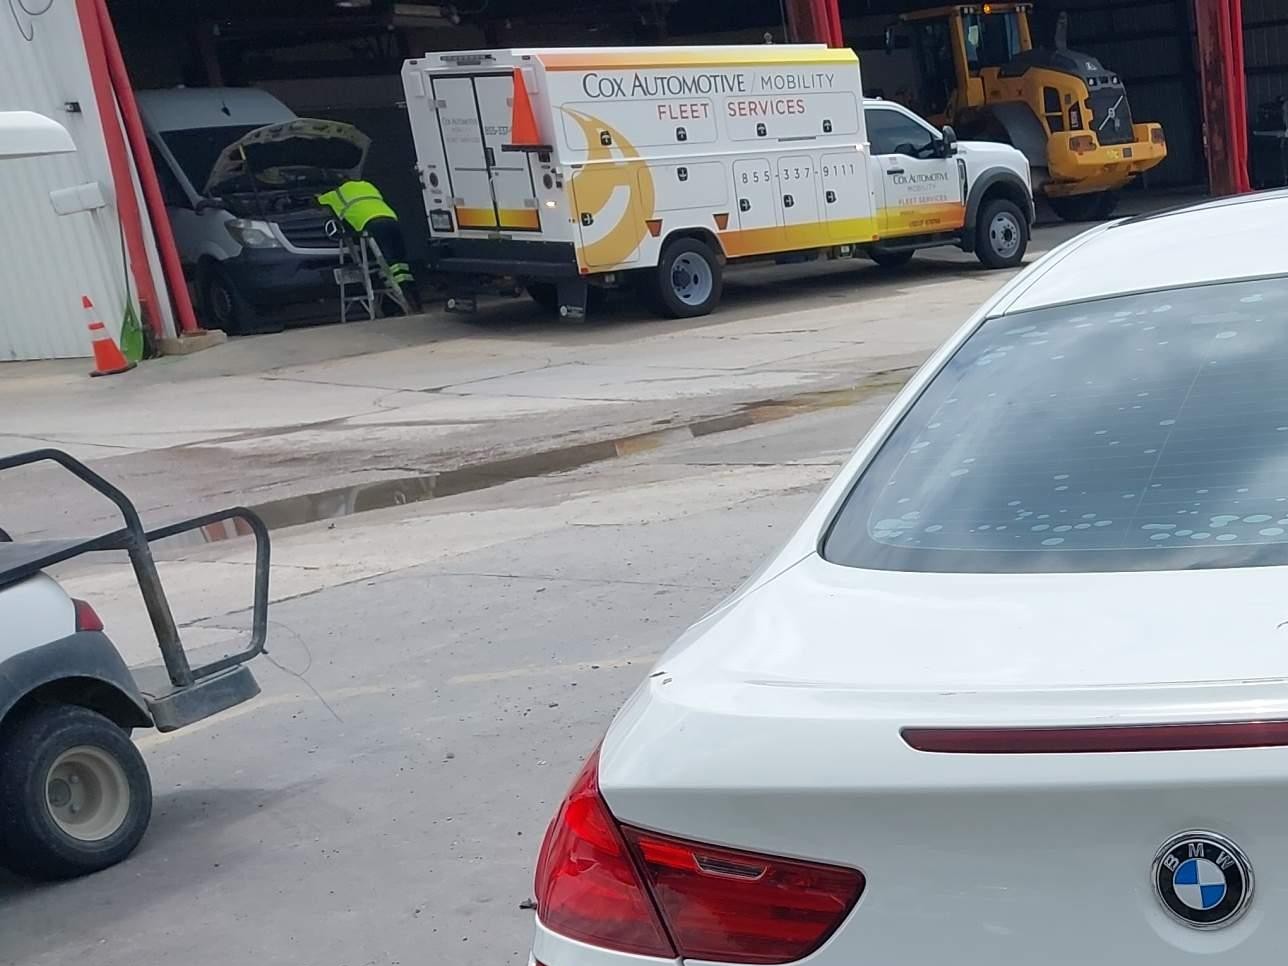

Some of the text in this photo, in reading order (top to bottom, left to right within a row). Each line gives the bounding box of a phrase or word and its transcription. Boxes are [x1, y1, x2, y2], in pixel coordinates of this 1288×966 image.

[631, 72, 746, 96] AUTOMOTIVE
[761, 74, 835, 90] MOBILITY
[657, 100, 806, 120] FLEET SERVICES
[1163, 843, 1235, 872] BMW
